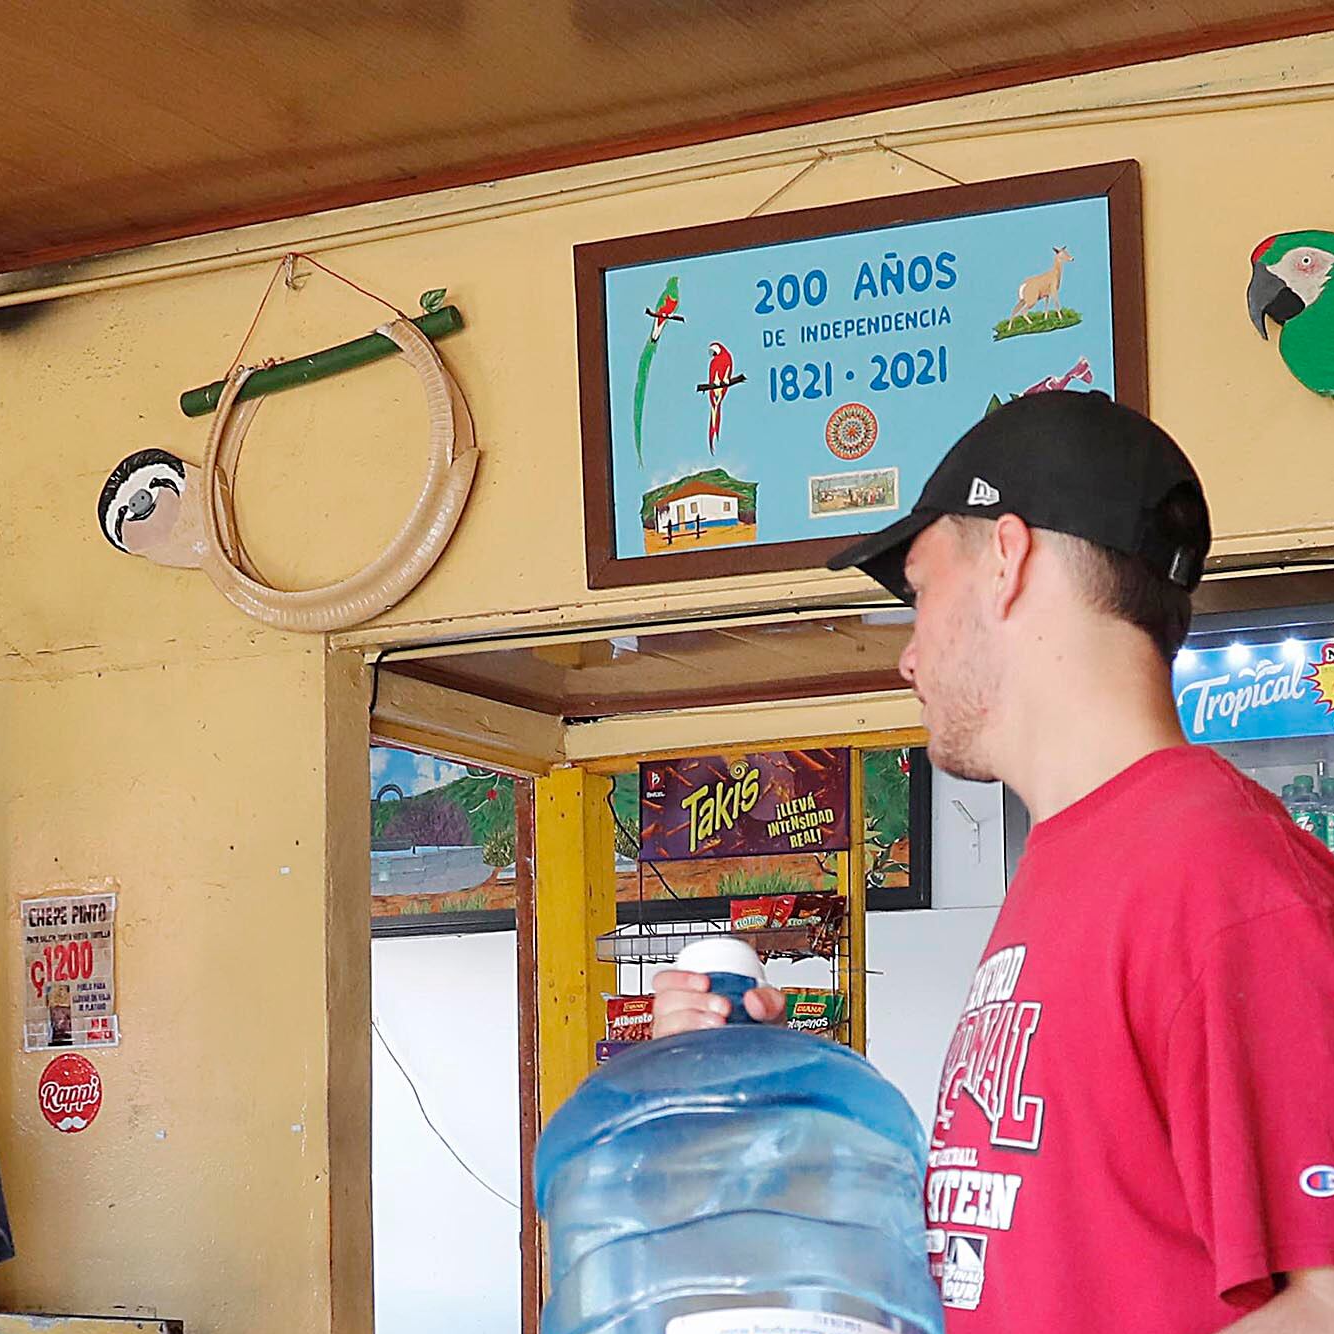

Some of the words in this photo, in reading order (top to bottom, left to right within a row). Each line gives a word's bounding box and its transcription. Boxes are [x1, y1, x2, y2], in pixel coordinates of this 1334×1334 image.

[754, 268, 827, 315] 200
[854, 252, 958, 301] AÑOS
[762, 329, 786, 348] DE
[800, 306, 952, 344] INDEPENDENCIA
[770, 362, 834, 404] 1821
[870, 346, 948, 391] 2021
[1176, 655, 1306, 735] Tropical
[681, 768, 760, 852] Takis
[767, 808, 835, 839] INTENSIDAD
[776, 793, 817, 821] ¡LLEVÁ
[789, 829, 823, 849] REAL!
[28, 906, 68, 928] CHEPE
[71, 902, 108, 924] PINTO
[41, 1075, 99, 1113] Rappi
